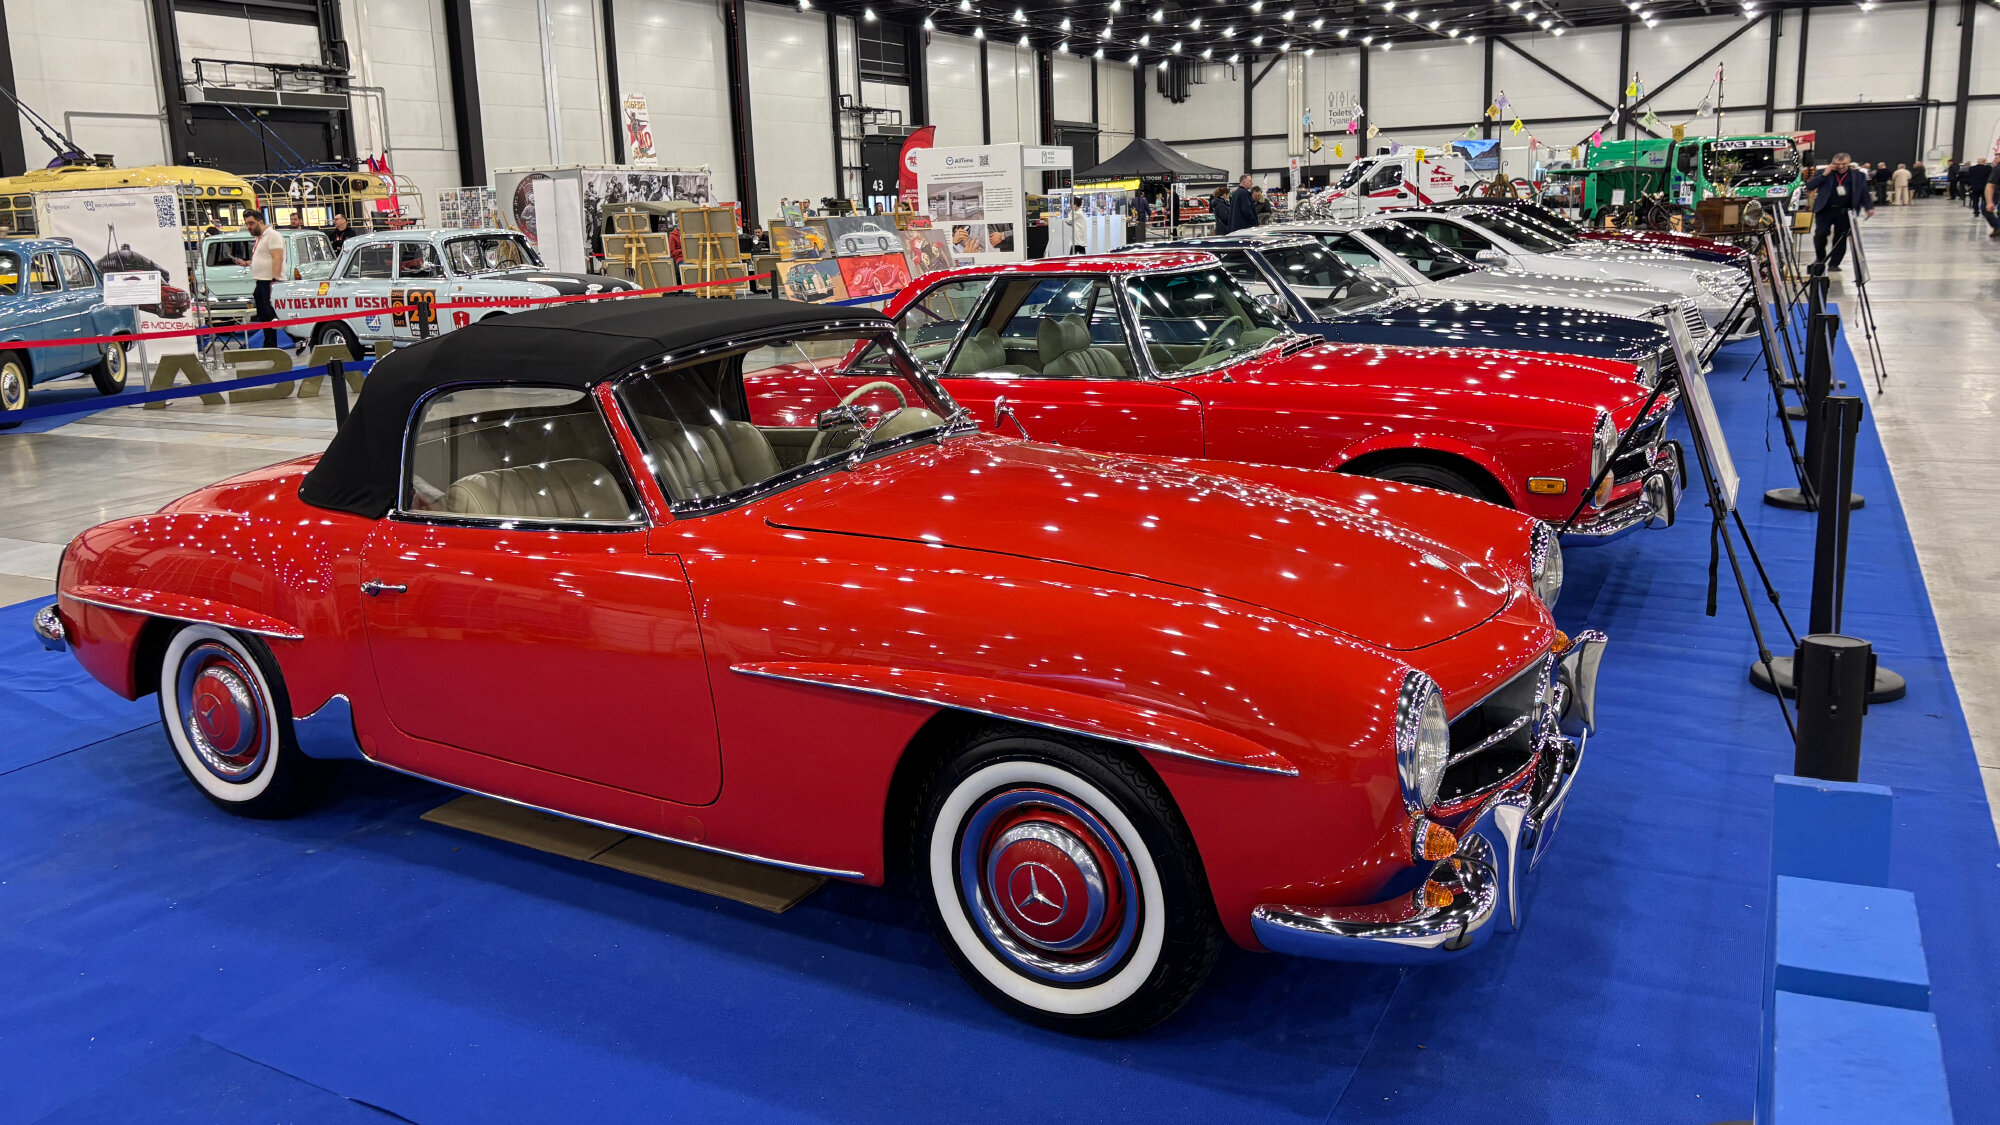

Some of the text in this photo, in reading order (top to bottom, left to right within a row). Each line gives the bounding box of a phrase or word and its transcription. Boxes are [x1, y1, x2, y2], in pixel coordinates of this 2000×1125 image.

[1329, 109, 1352, 117] Toilets
[288, 181, 316, 199] 42
[872, 179, 884, 192] 43
[274, 296, 389, 310] AVTOEXPORT USSR
[151, 321, 194, 330] МОСКВИЧ
